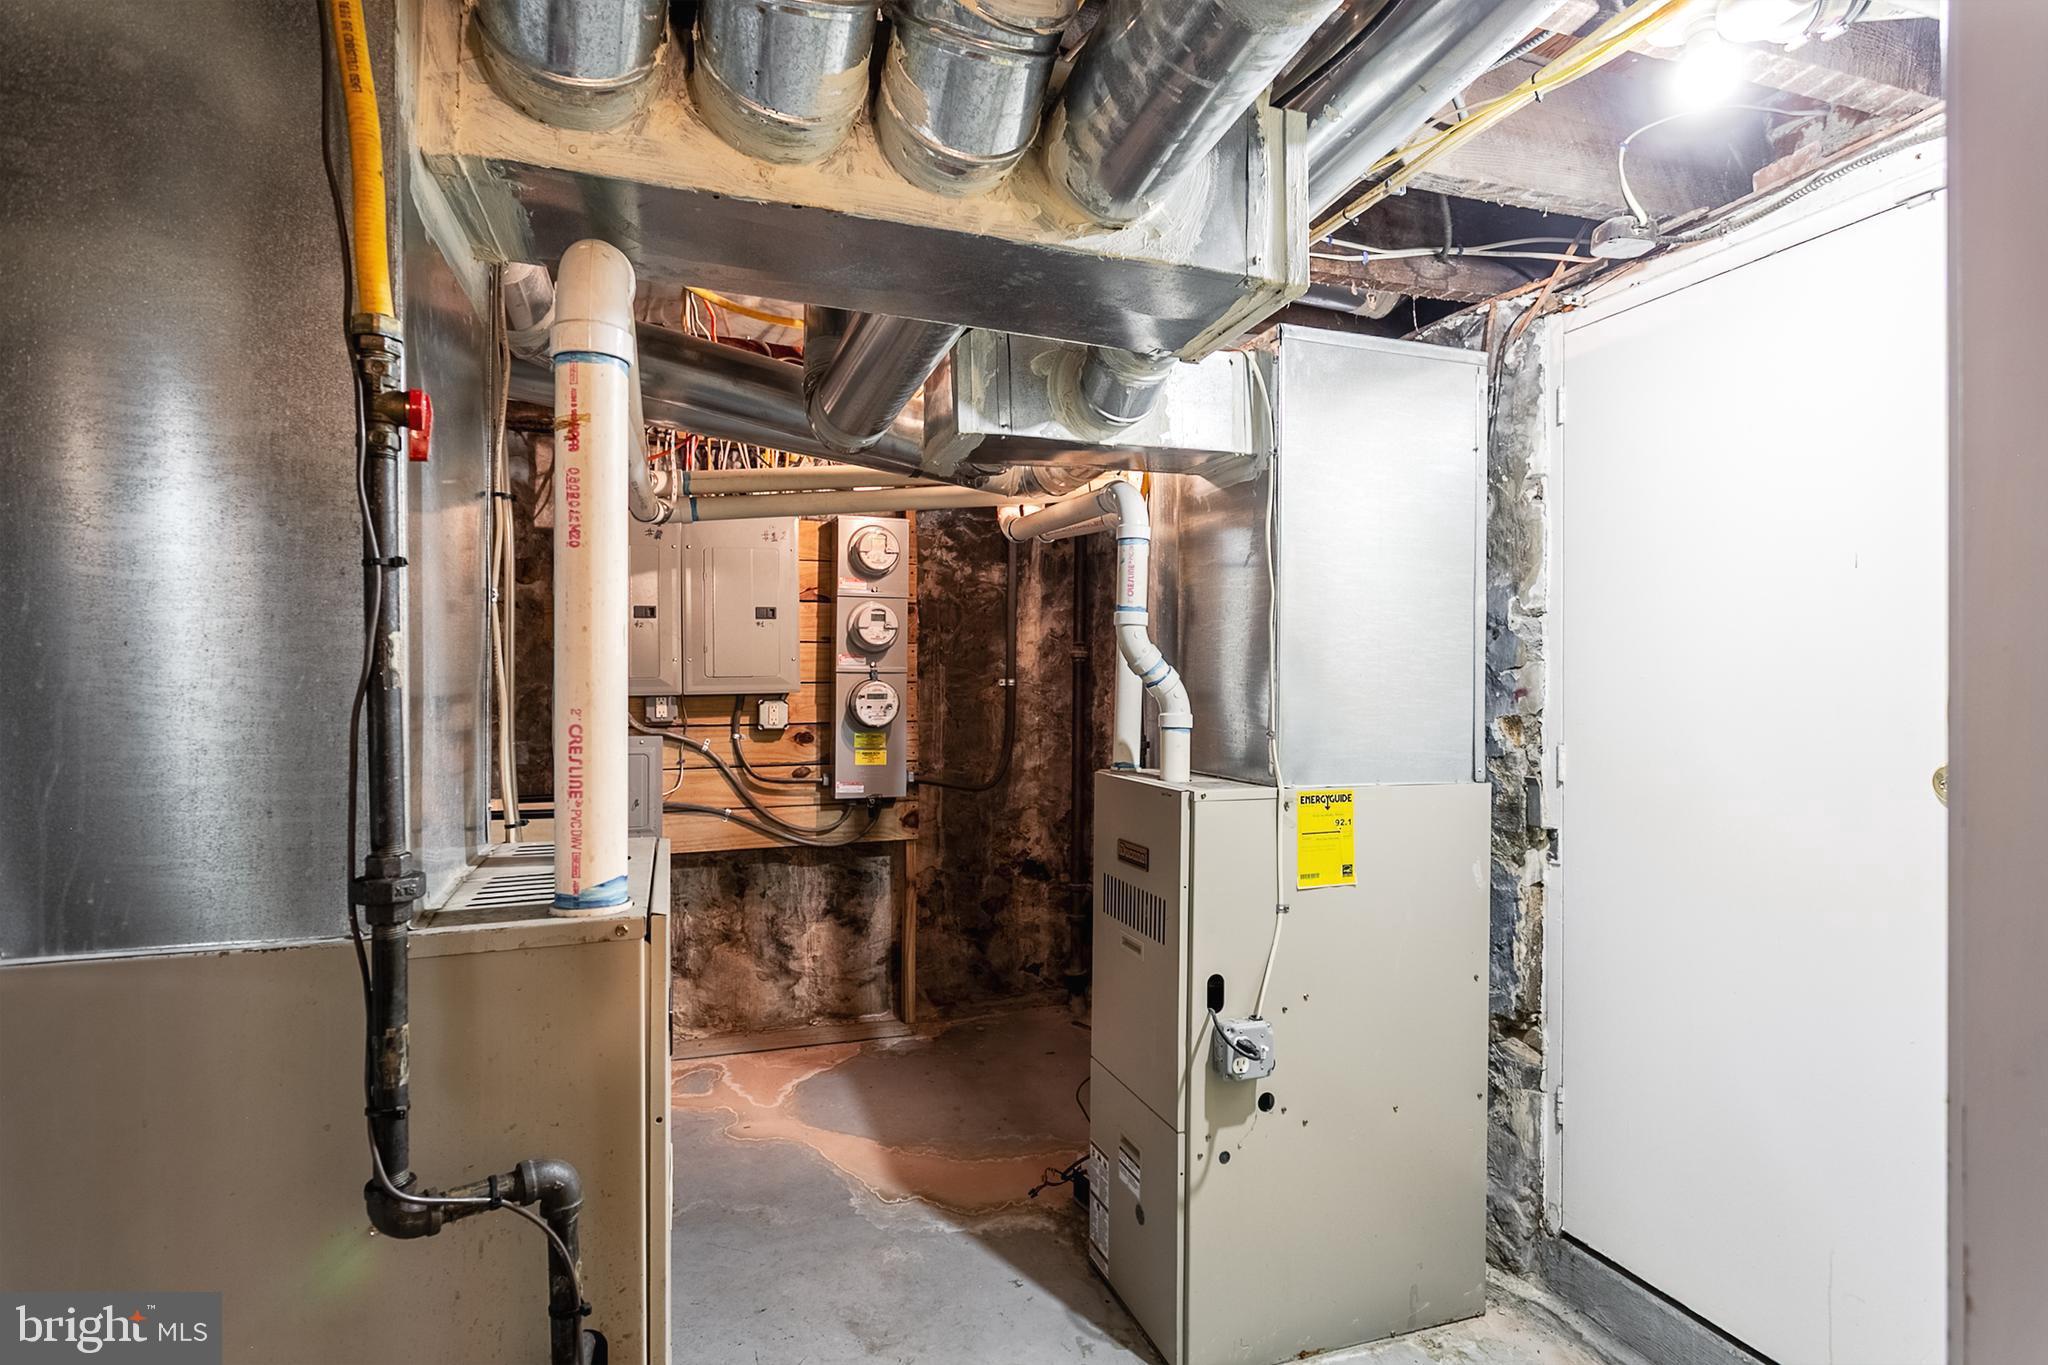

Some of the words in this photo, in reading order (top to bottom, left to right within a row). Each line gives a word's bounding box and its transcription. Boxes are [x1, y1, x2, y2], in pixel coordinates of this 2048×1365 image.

[568, 723, 583, 799] CRESLINE
[1300, 793, 1353, 806] ENERGYGUIDE
[1334, 818, 1352, 827] 92.1
